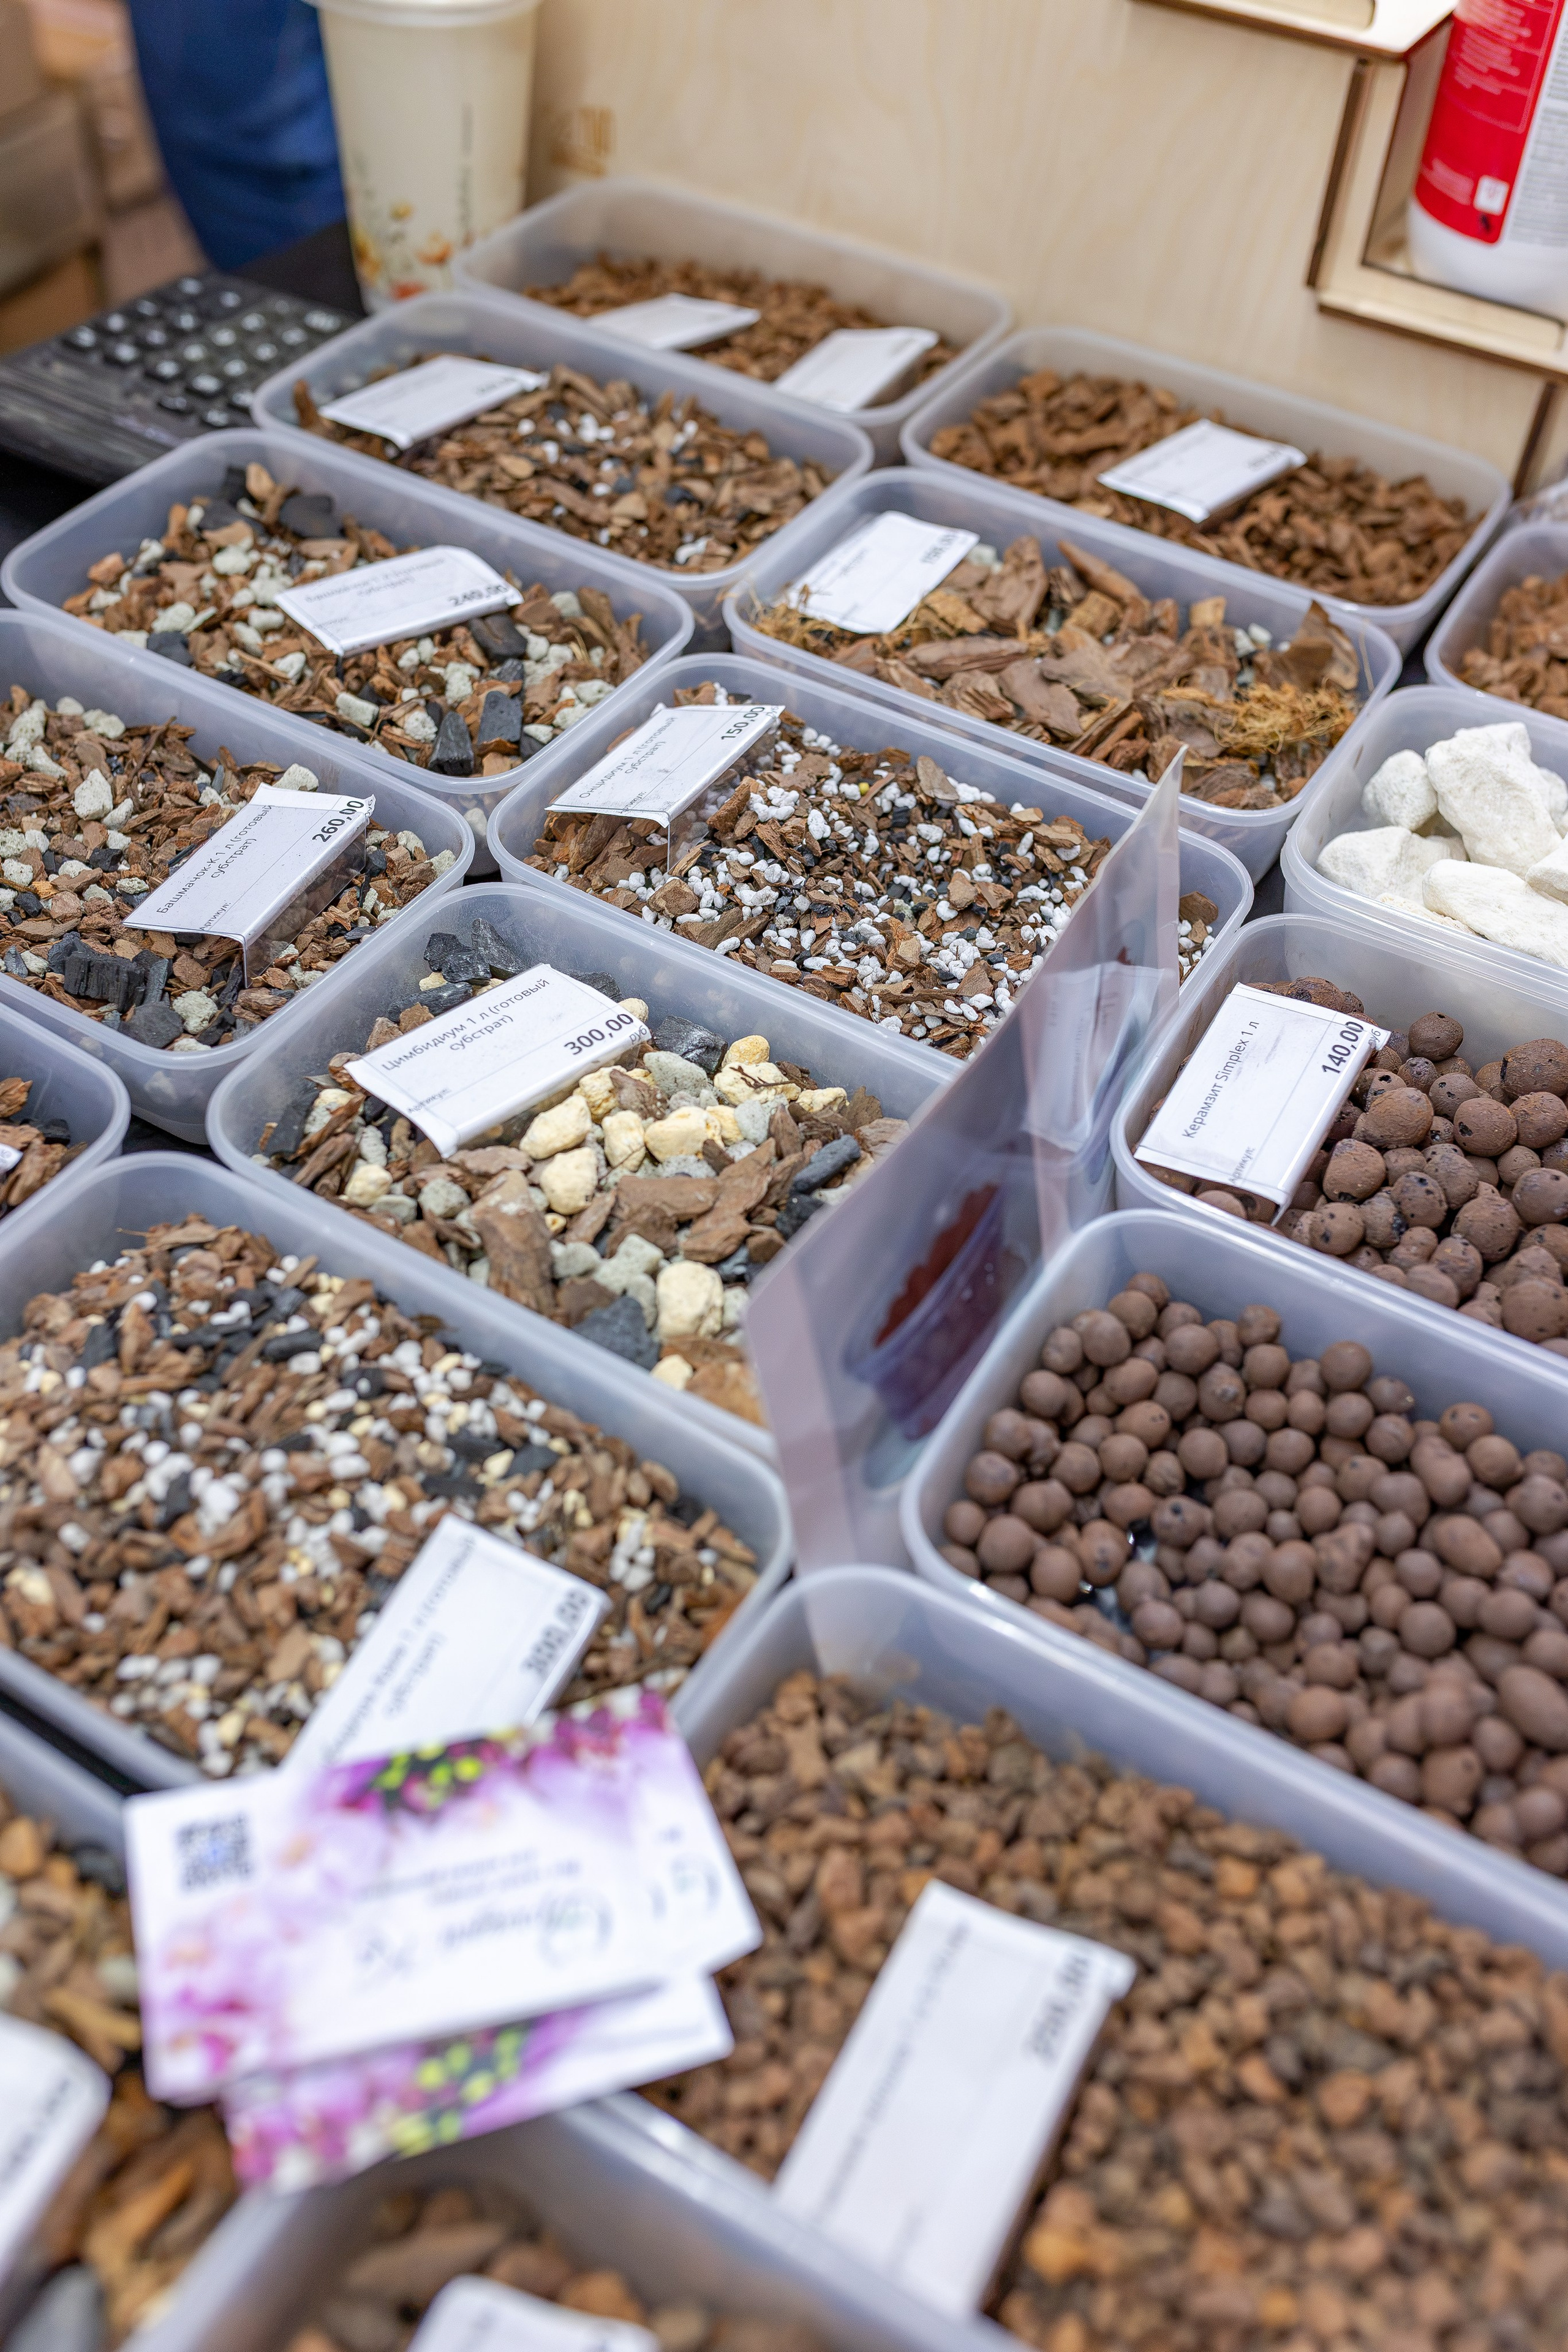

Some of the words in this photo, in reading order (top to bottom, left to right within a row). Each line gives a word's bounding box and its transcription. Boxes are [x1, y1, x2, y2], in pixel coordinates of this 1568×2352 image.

[721, 707, 765, 740] 150,00
[625, 741, 666, 774] субстрат)
[579, 762, 627, 798] Онцидиум
[312, 801, 364, 843] 260,00
[156, 858, 220, 914] Башмачок-К
[230, 805, 273, 843] (готовый
[211, 838, 257, 878] субстрат)
[198, 900, 232, 931] Артикул:
[381, 1023, 467, 1071] Цимбидиум
[479, 1011, 490, 1020] л
[488, 979, 550, 1015] (готовый
[450, 1014, 514, 1052] субстрат)
[564, 1014, 634, 1055] 300,00
[629, 1025, 647, 1045] руб
[1321, 1021, 1364, 1074] 140,00
[1182, 1082, 1224, 1139] Керамзит
[1215, 1039, 1250, 1082] Simplex
